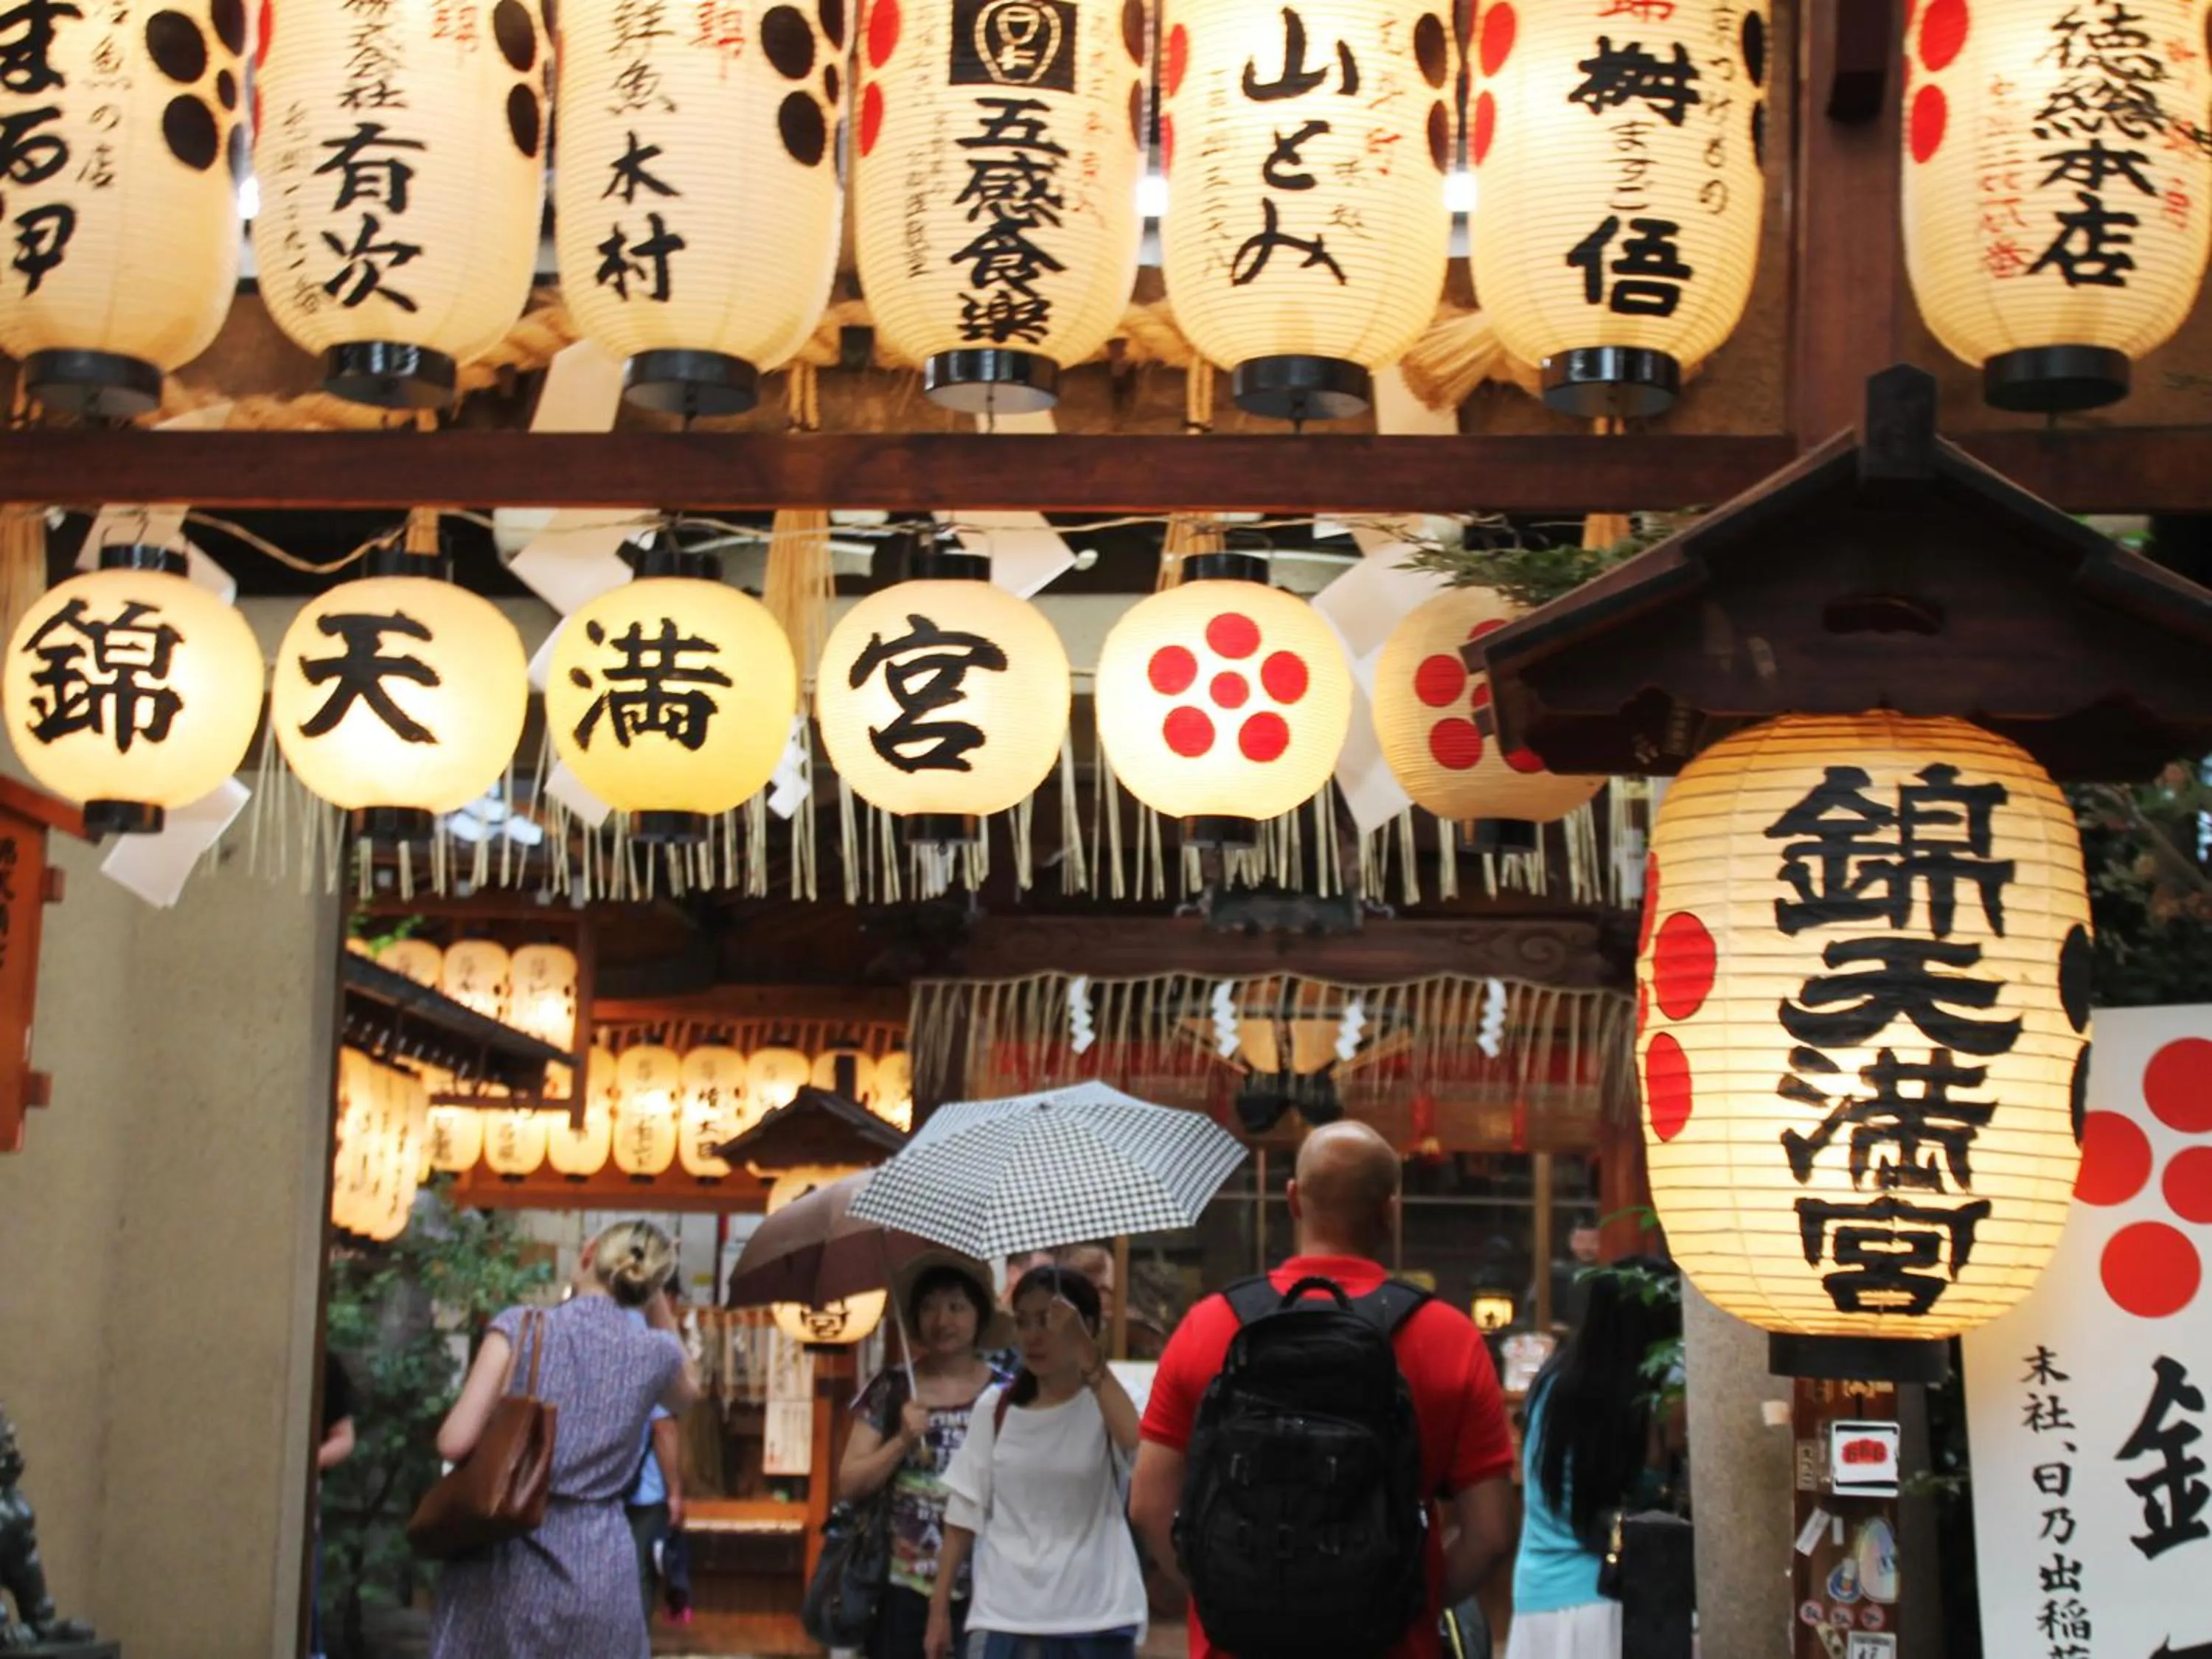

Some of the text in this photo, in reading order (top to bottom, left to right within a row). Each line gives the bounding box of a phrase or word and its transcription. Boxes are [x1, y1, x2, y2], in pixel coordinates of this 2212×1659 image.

[312, 122, 428, 313] 有次
[596, 130, 686, 304] 木村
[1231, 6, 1359, 288] 山とみ
[22, 598, 1008, 773] 錦 天 満 宮
[1763, 762, 2023, 1316] 錦天満宮
